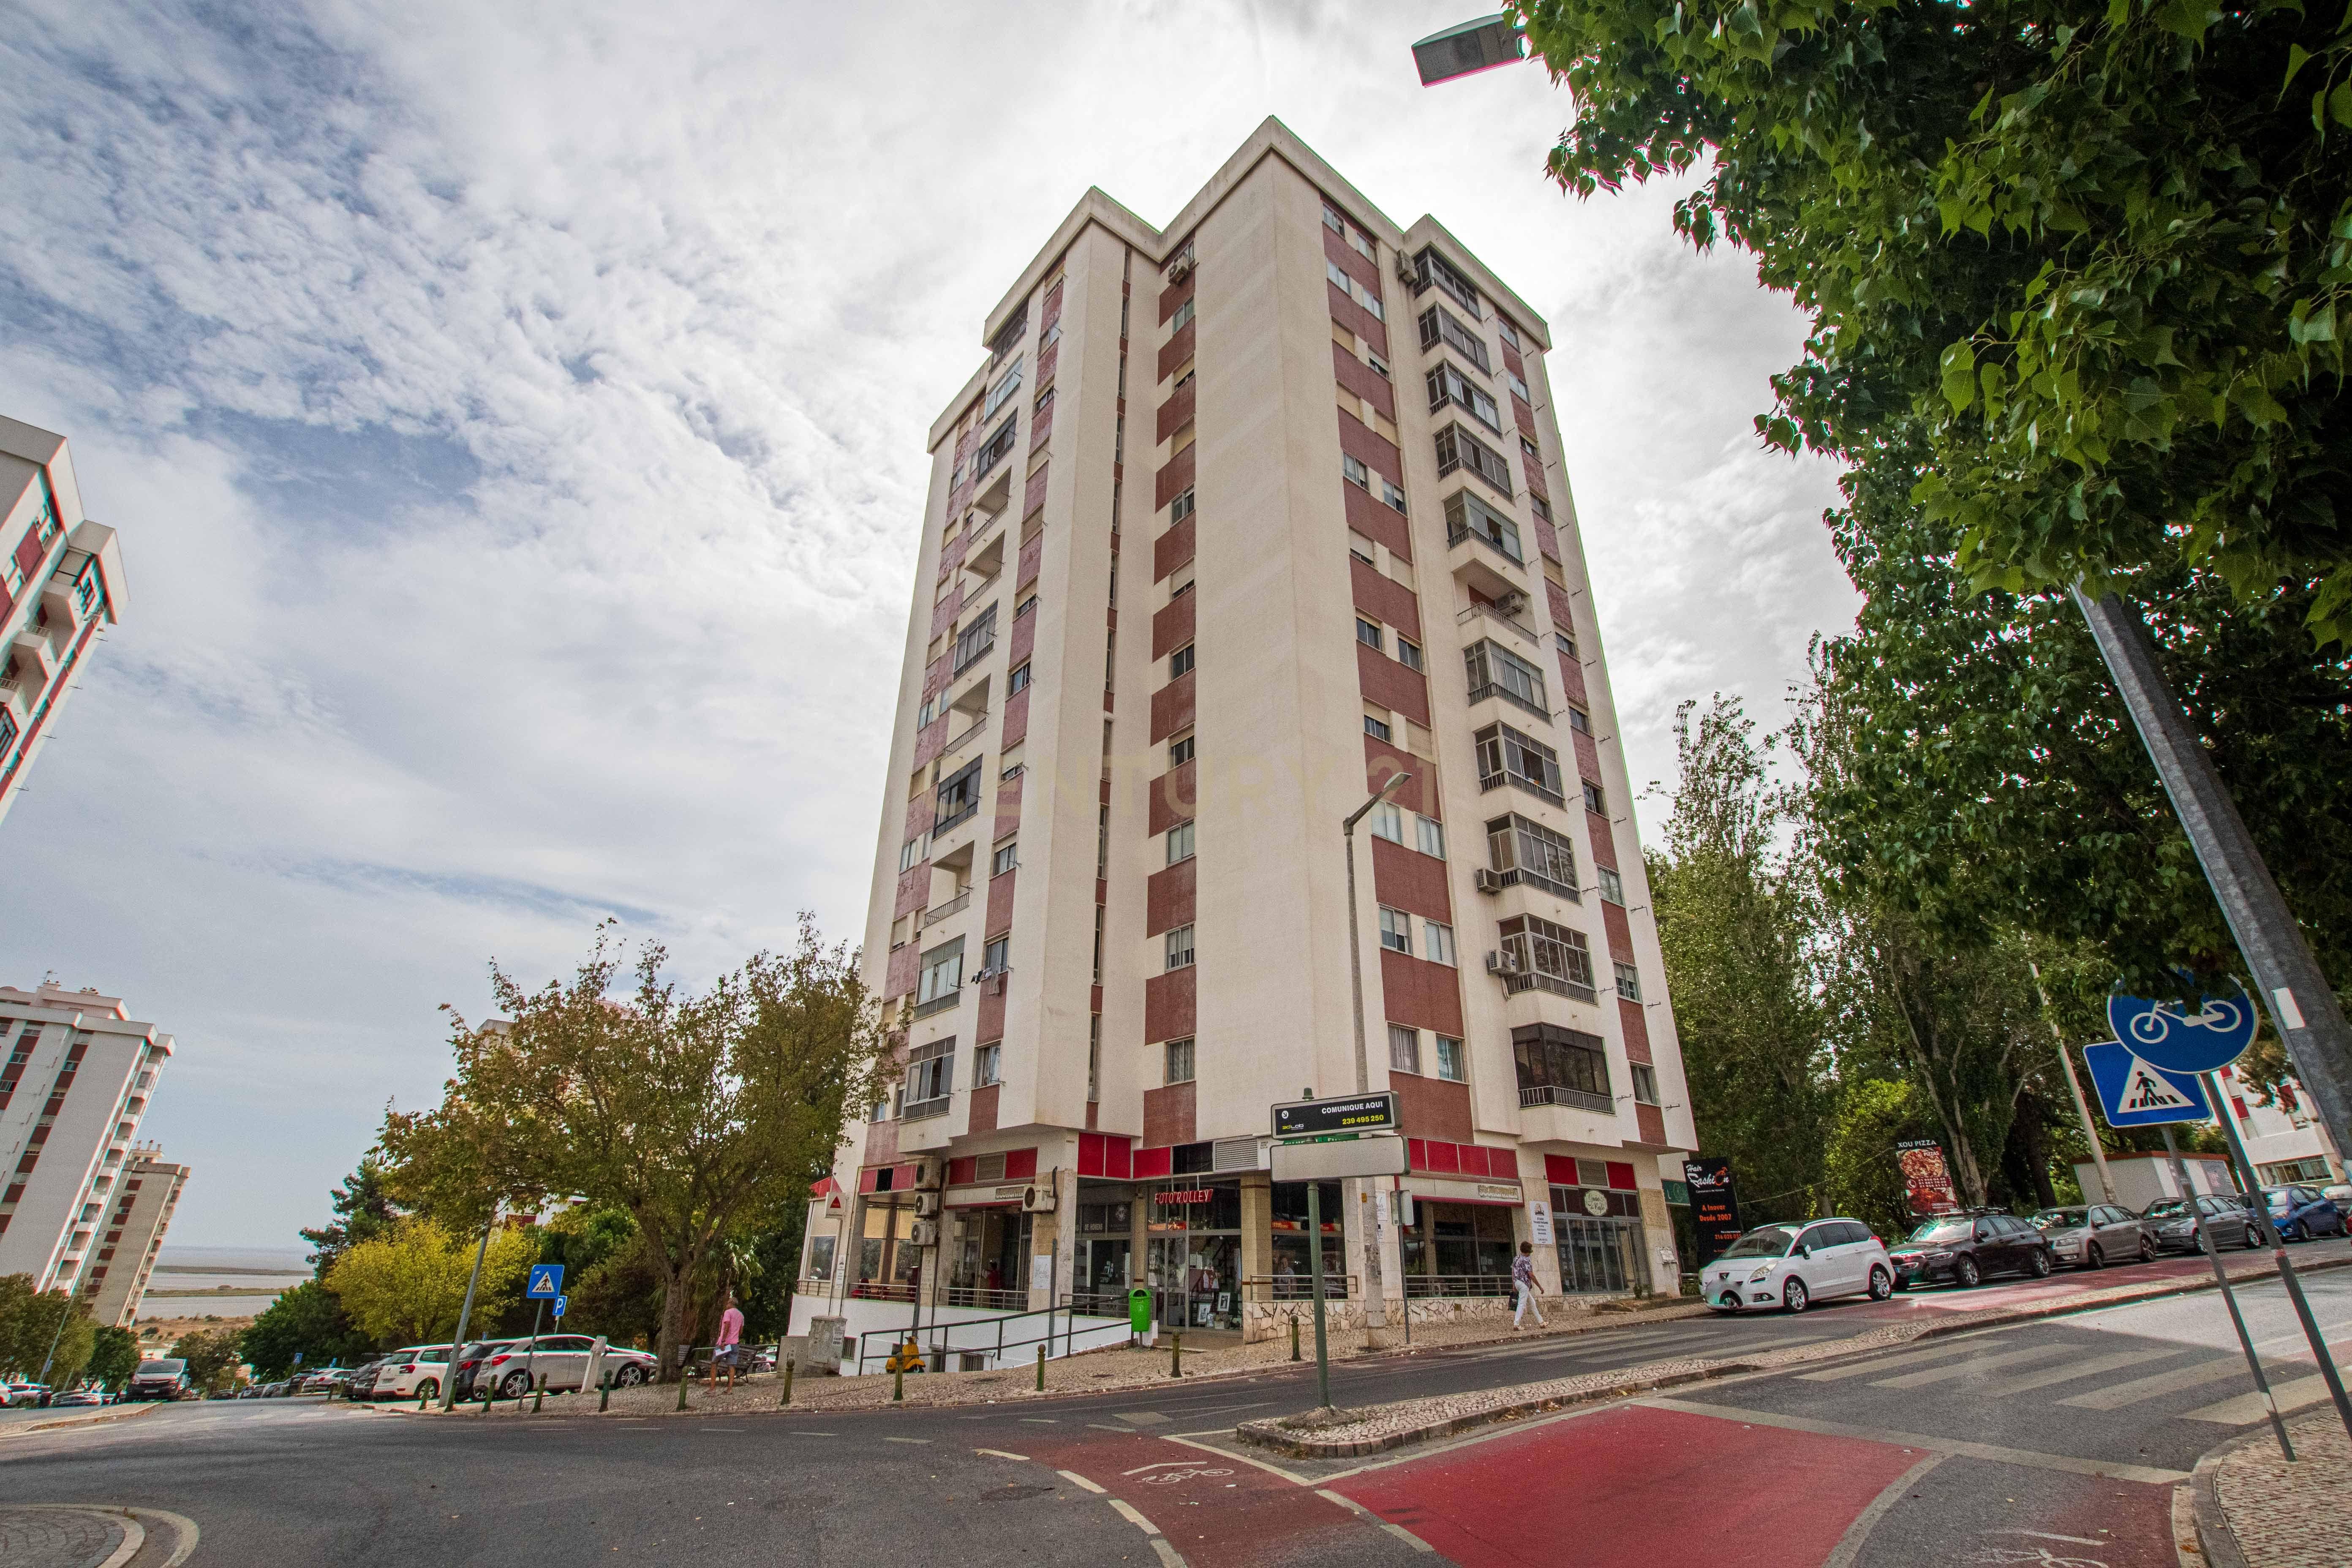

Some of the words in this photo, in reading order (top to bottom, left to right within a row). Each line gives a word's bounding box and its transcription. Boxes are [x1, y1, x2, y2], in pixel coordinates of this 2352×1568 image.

[1321, 1103, 1364, 1114] COMUNIQUE
[1365, 1101, 1383, 1109] AQUI
[1686, 1164, 1703, 1173] Hair
[1154, 1192, 1174, 1203] FOTO
[1176, 1189, 1209, 1203] ROLLEY
[555, 1298, 564, 1313] P
